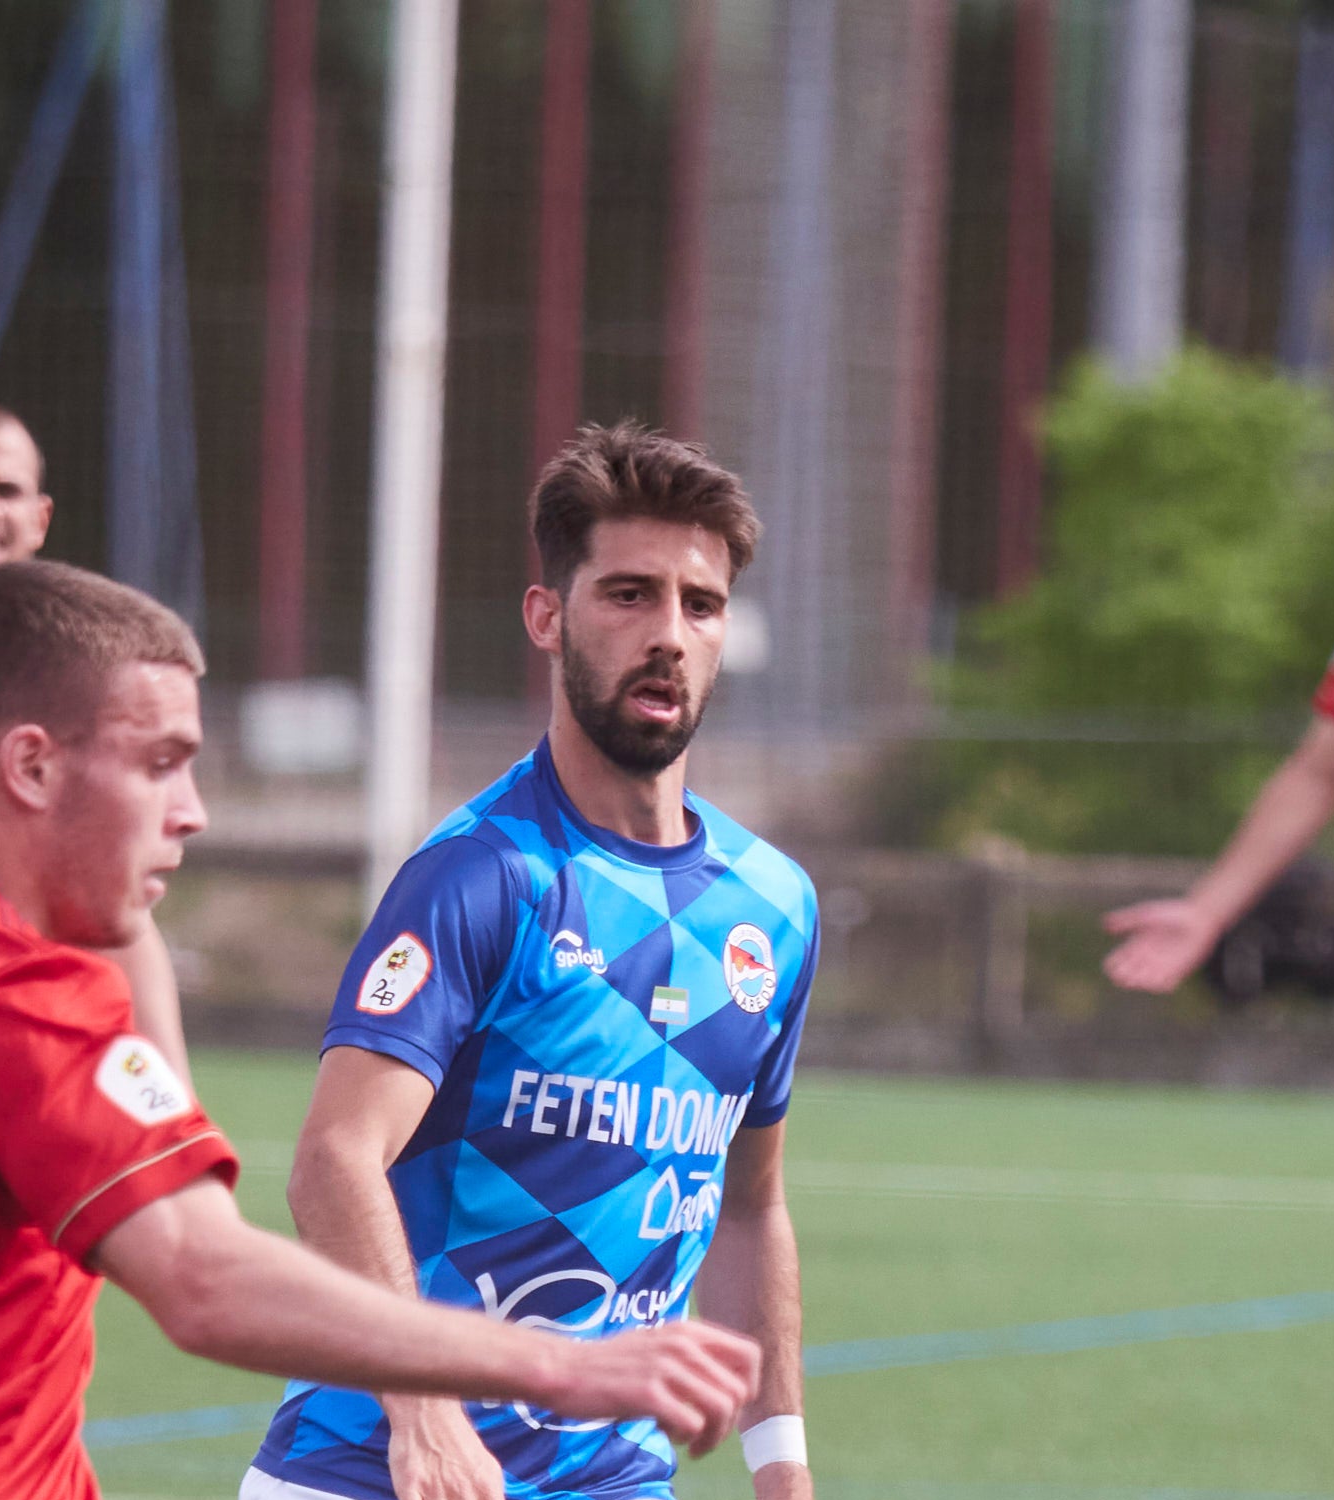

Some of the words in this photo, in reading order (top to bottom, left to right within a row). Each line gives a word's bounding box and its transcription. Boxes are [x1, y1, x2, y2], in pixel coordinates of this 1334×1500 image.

[370, 978, 395, 1006] 2B
[502, 1069, 640, 1146] FETEN
[645, 1086, 754, 1156] DOMU
